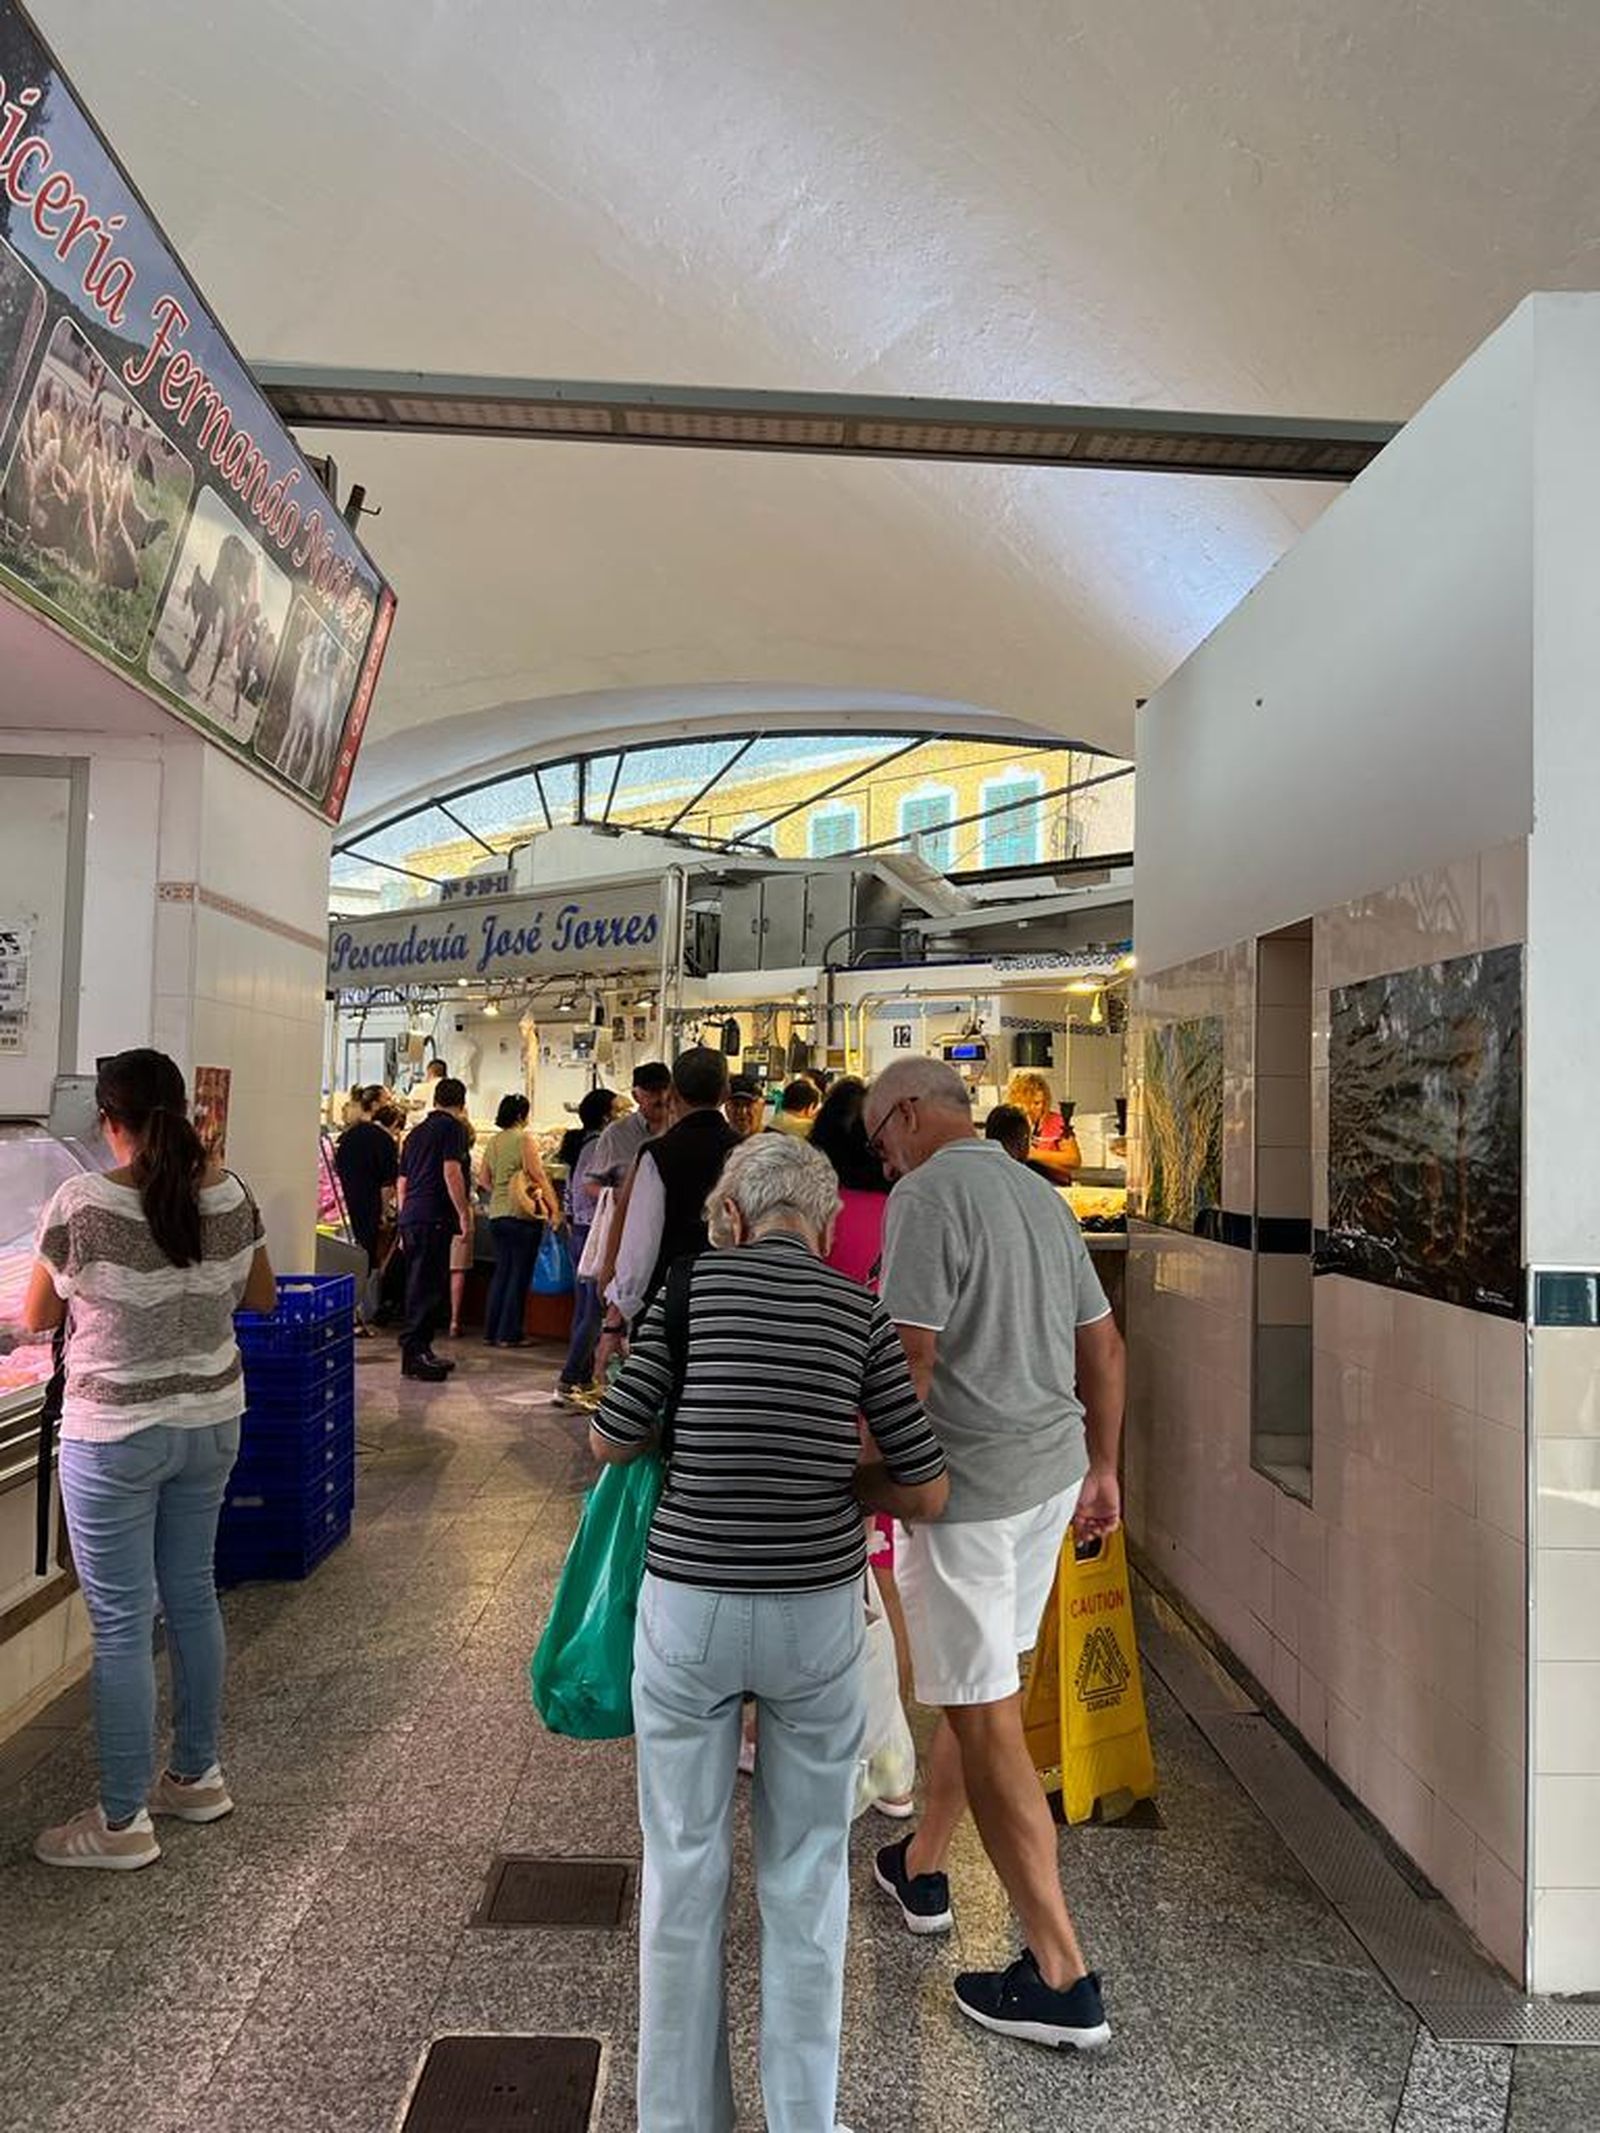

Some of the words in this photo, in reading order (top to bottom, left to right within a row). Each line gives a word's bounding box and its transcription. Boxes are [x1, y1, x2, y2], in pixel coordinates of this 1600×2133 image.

[123, 297, 300, 549] Fernando
[331, 922, 469, 973] Pescadería
[476, 911, 542, 973] José
[551, 904, 658, 951] Torres
[894, 1027, 911, 1048] 12
[1070, 1589, 1124, 1618] CAUTION
